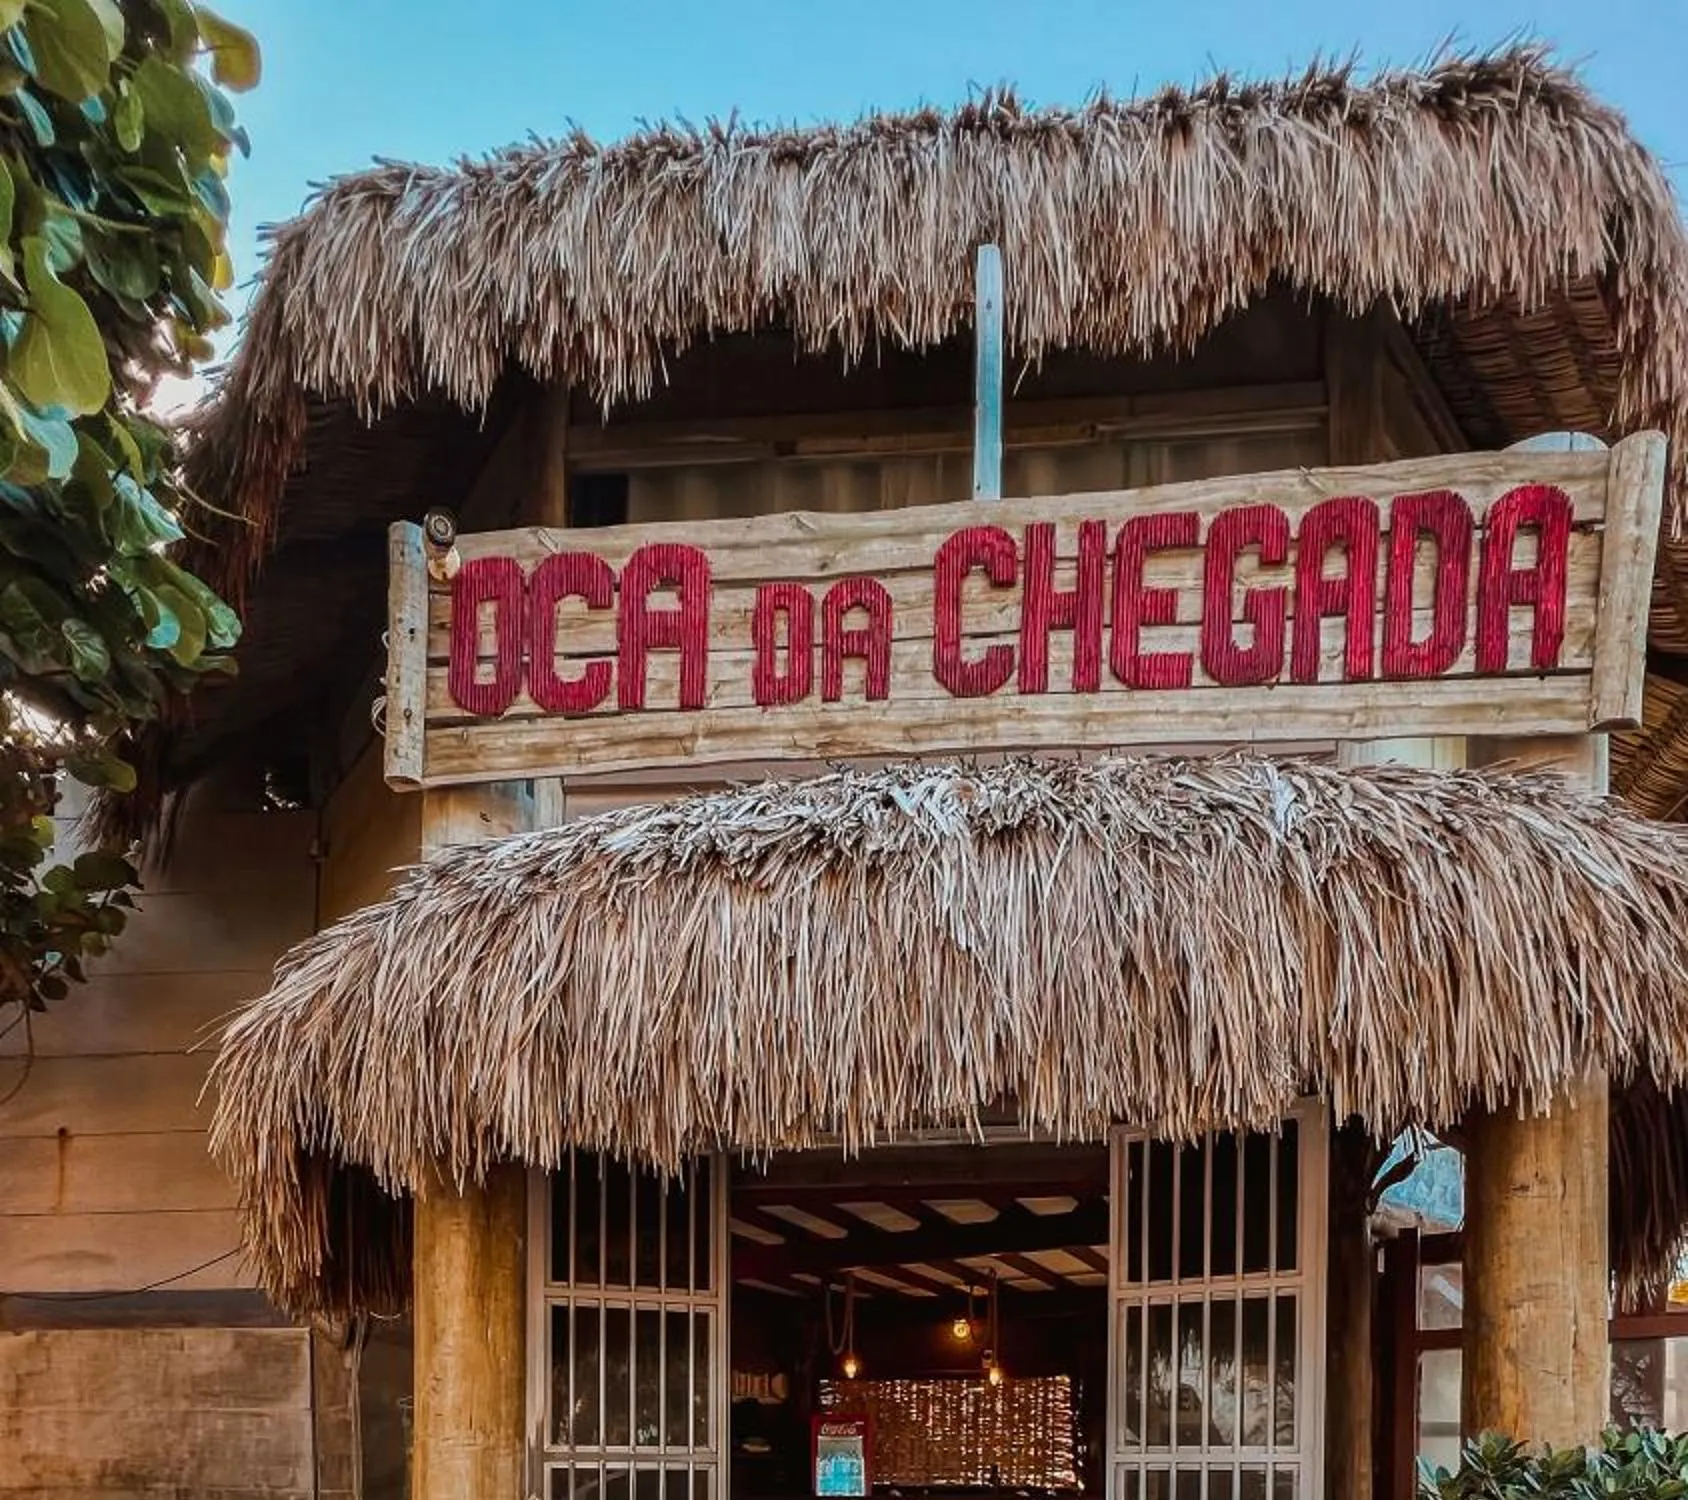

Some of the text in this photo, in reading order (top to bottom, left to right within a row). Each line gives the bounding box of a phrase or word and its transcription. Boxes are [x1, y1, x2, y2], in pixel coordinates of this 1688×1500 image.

[447, 484, 1577, 716] OCA DA CHEGADA
